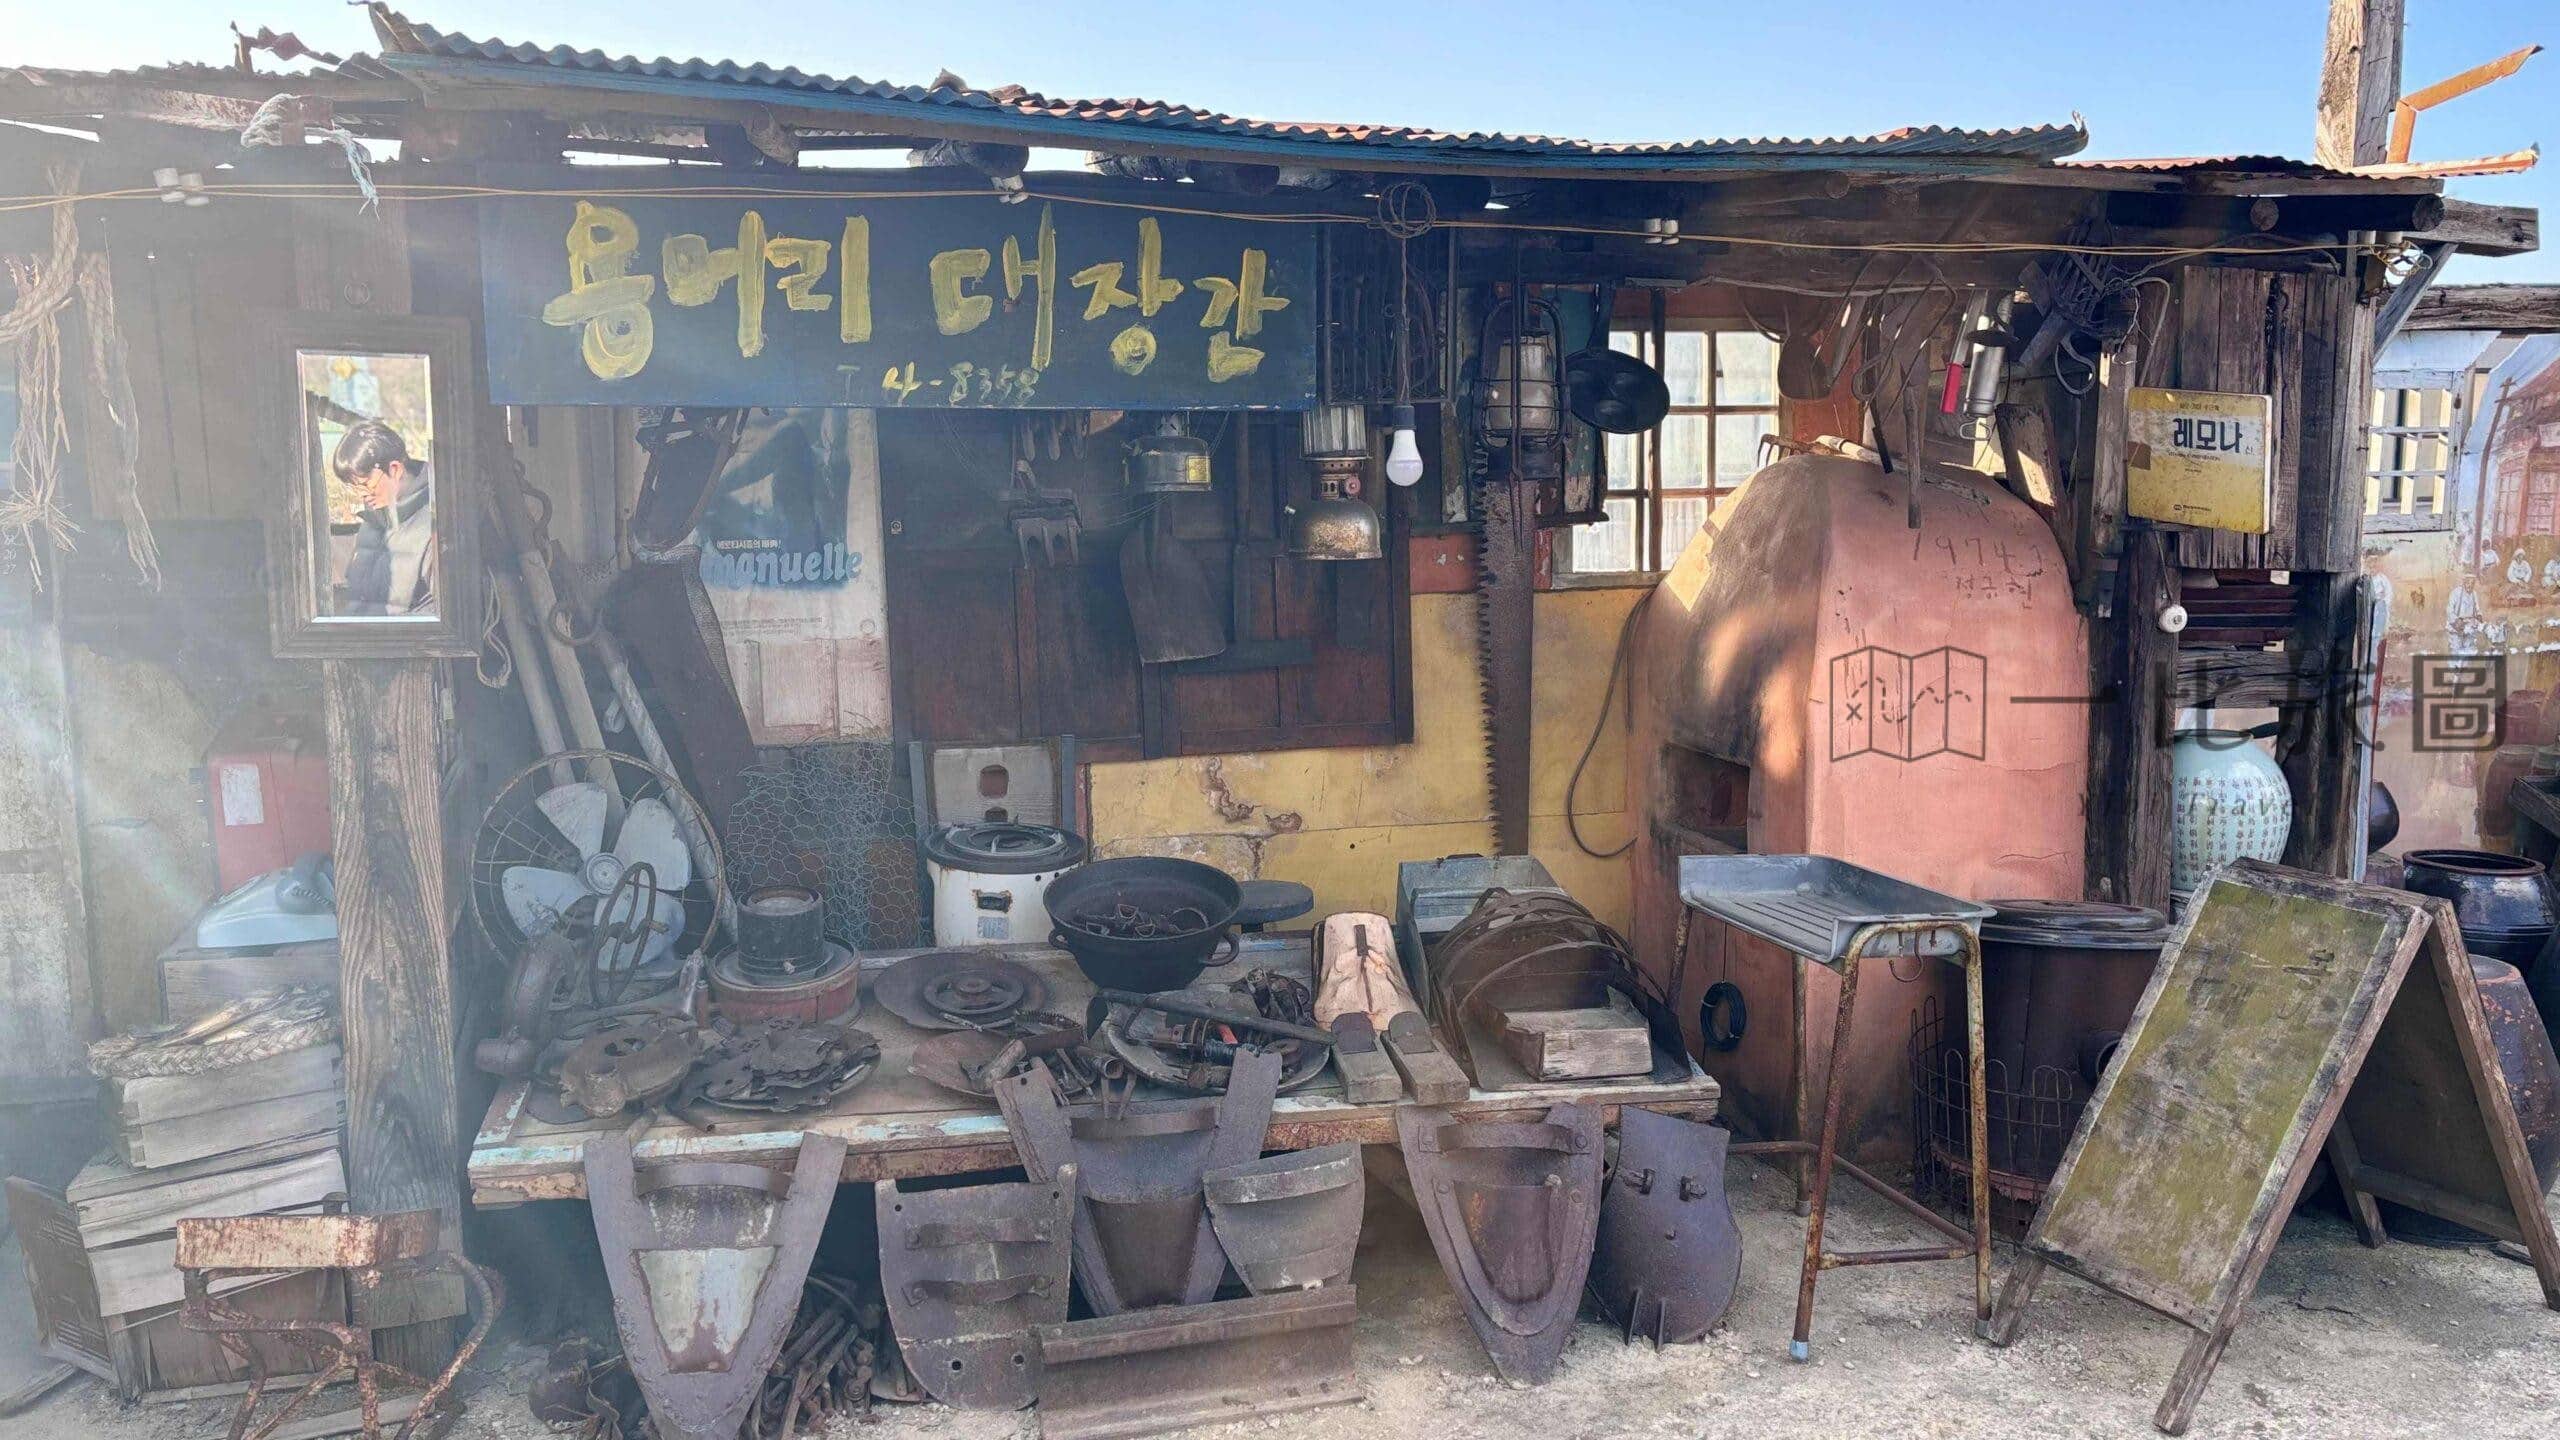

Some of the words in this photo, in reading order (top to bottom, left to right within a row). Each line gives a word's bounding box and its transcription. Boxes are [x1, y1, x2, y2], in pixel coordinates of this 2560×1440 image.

[541, 199, 873, 381] 용머리
[928, 202, 1291, 384] 대장간
[2172, 417, 2243, 453] 레모나
